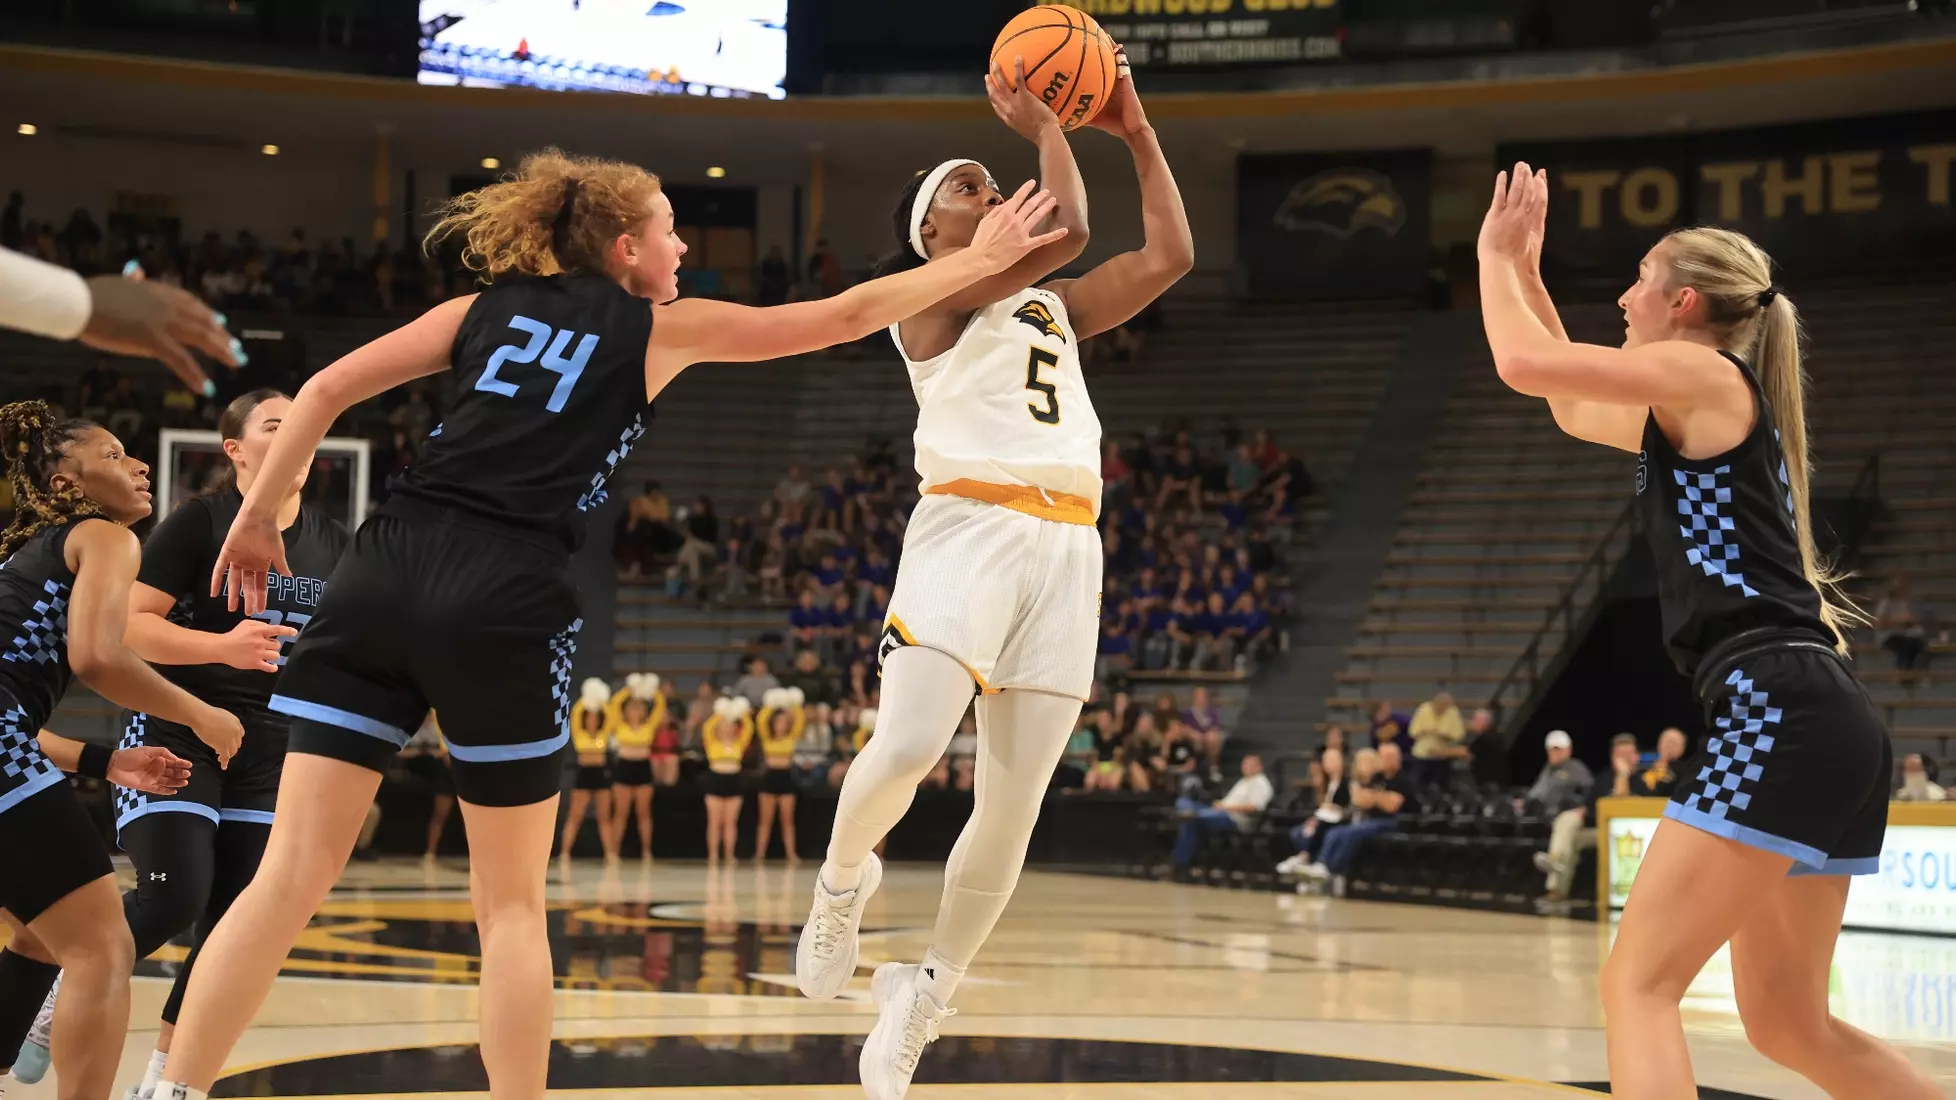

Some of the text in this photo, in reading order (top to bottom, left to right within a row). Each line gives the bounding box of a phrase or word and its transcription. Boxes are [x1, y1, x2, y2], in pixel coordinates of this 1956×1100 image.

[1560, 166, 1680, 230] TO
[1699, 148, 1883, 222] THE
[474, 315, 601, 413] 24
[1026, 345, 1060, 425] 5
